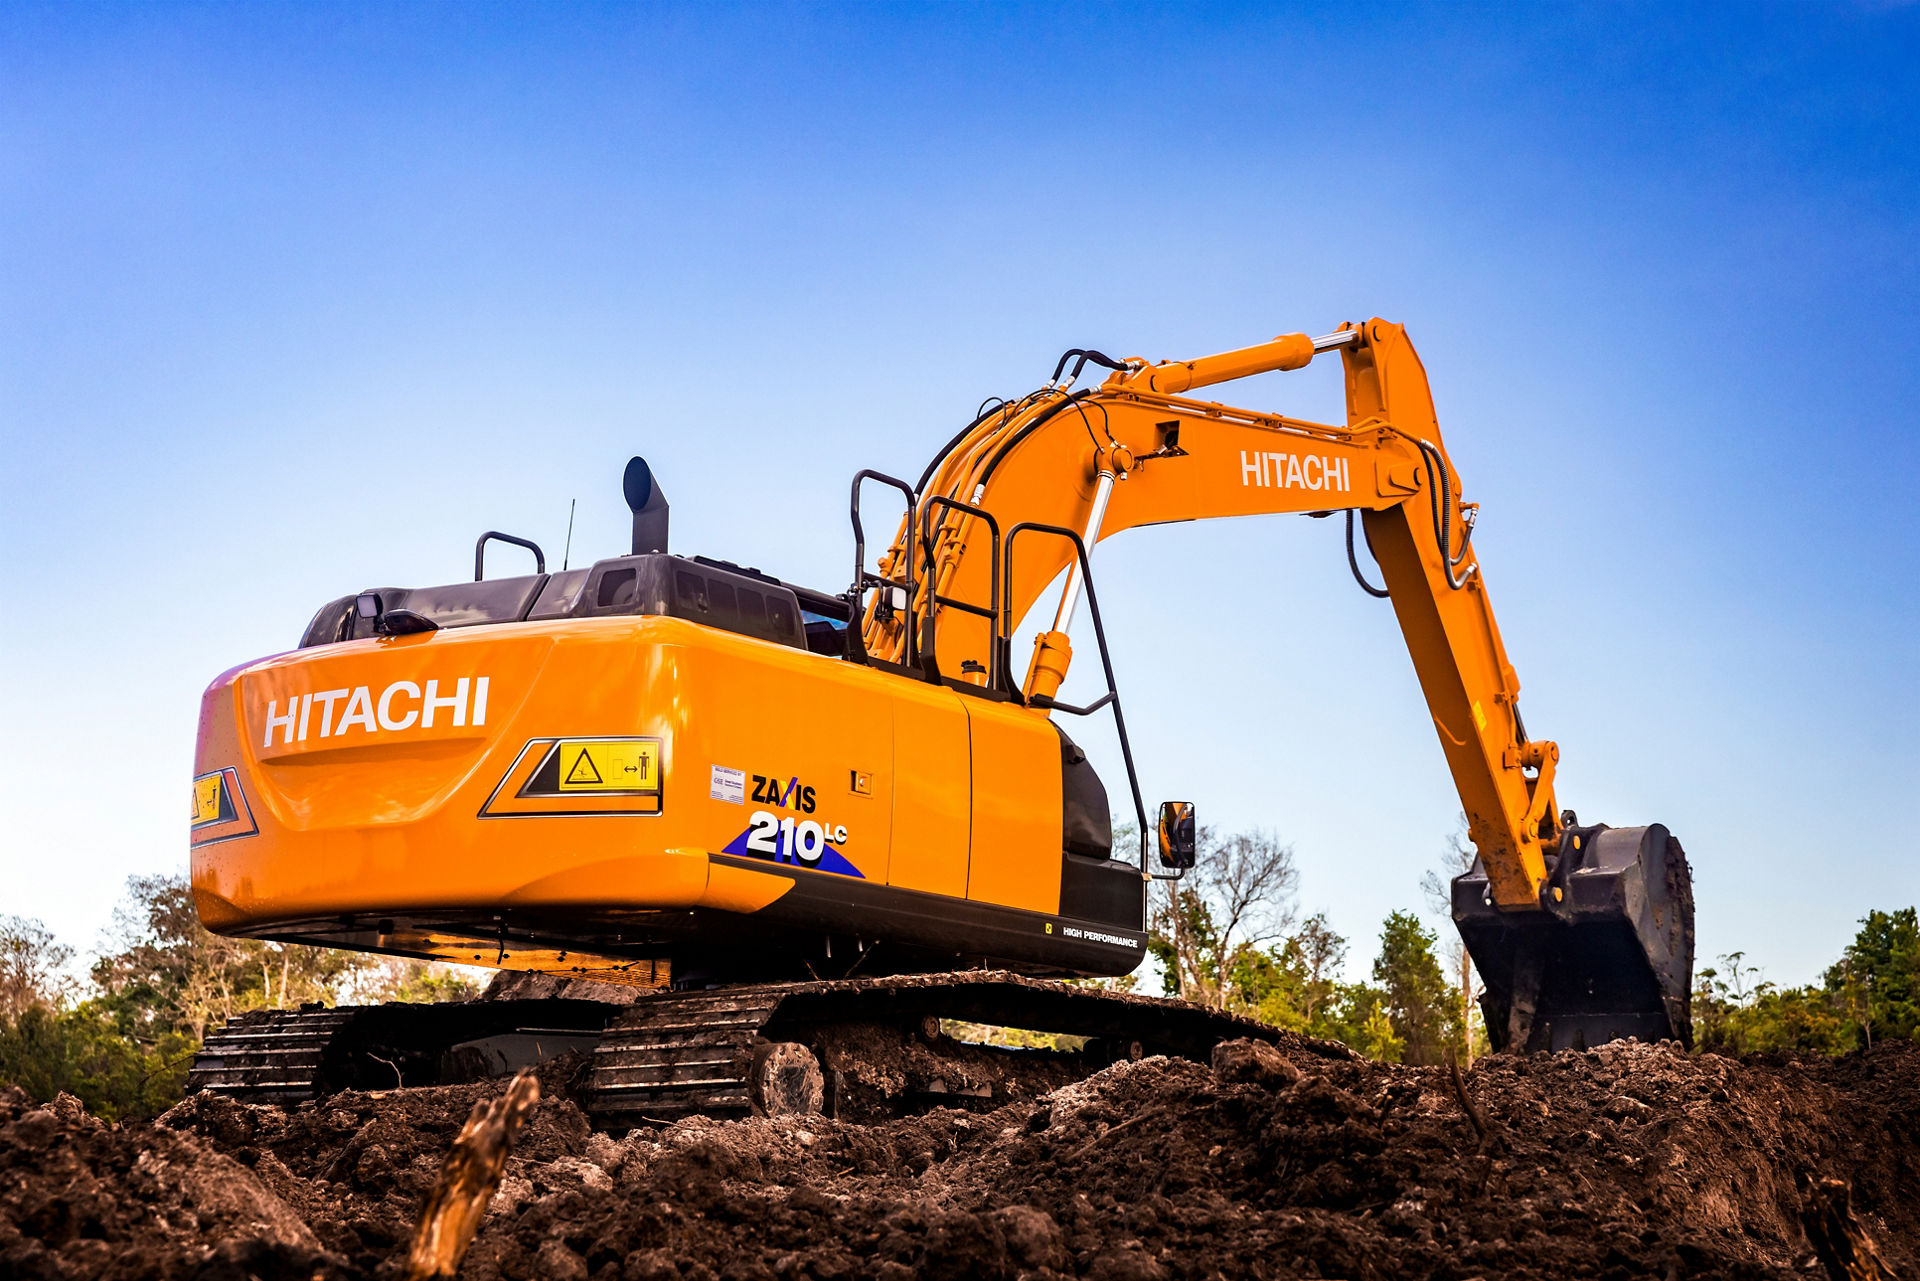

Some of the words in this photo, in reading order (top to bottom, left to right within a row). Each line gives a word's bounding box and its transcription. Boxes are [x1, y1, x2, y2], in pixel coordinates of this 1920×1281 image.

[1240, 451, 1350, 492] HITACHI
[263, 676, 490, 748] HITACHI
[751, 774, 816, 814] ZAXIS
[1063, 926, 1082, 938] HIGH
[1083, 930, 1138, 948] PERFORMANCE
